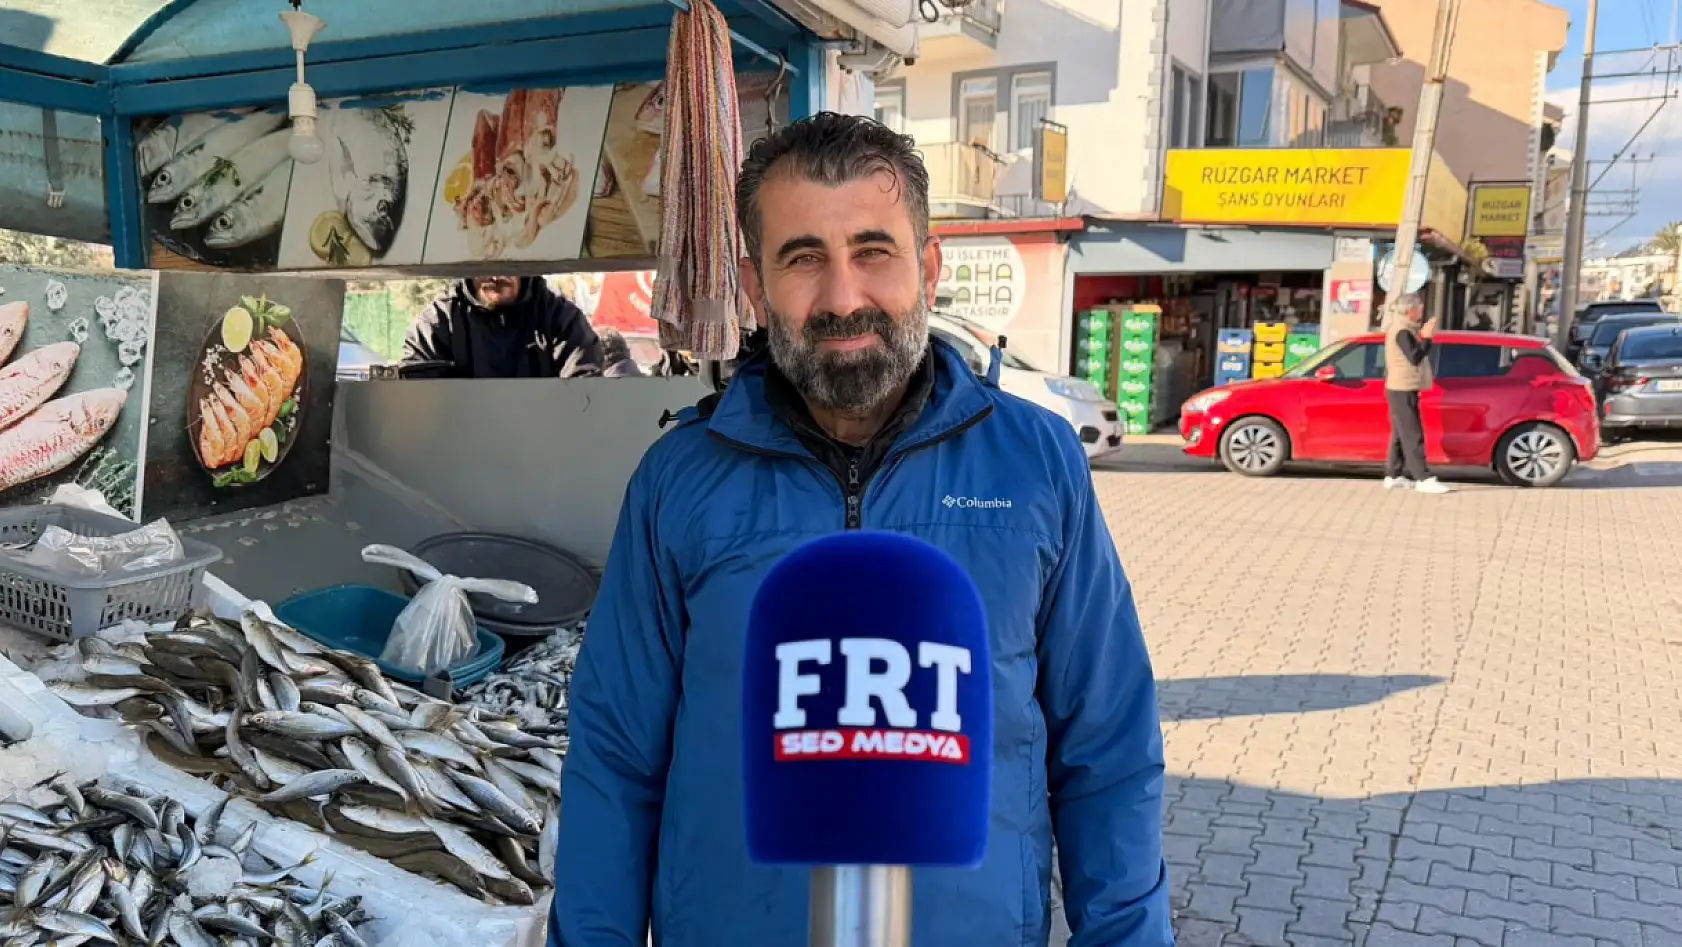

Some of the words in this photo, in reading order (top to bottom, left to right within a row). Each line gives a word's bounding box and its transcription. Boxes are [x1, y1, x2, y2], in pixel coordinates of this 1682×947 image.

[1284, 166, 1369, 185] MARKET
[1216, 191, 1259, 210] ŞANS
[1263, 191, 1346, 208] OYUNLARI
[1480, 212, 1521, 222] MARKET
[956, 496, 1012, 509] Columbia
[773, 637, 972, 733] FRT
[781, 731, 845, 755] SED
[851, 731, 963, 760] MEDYA
